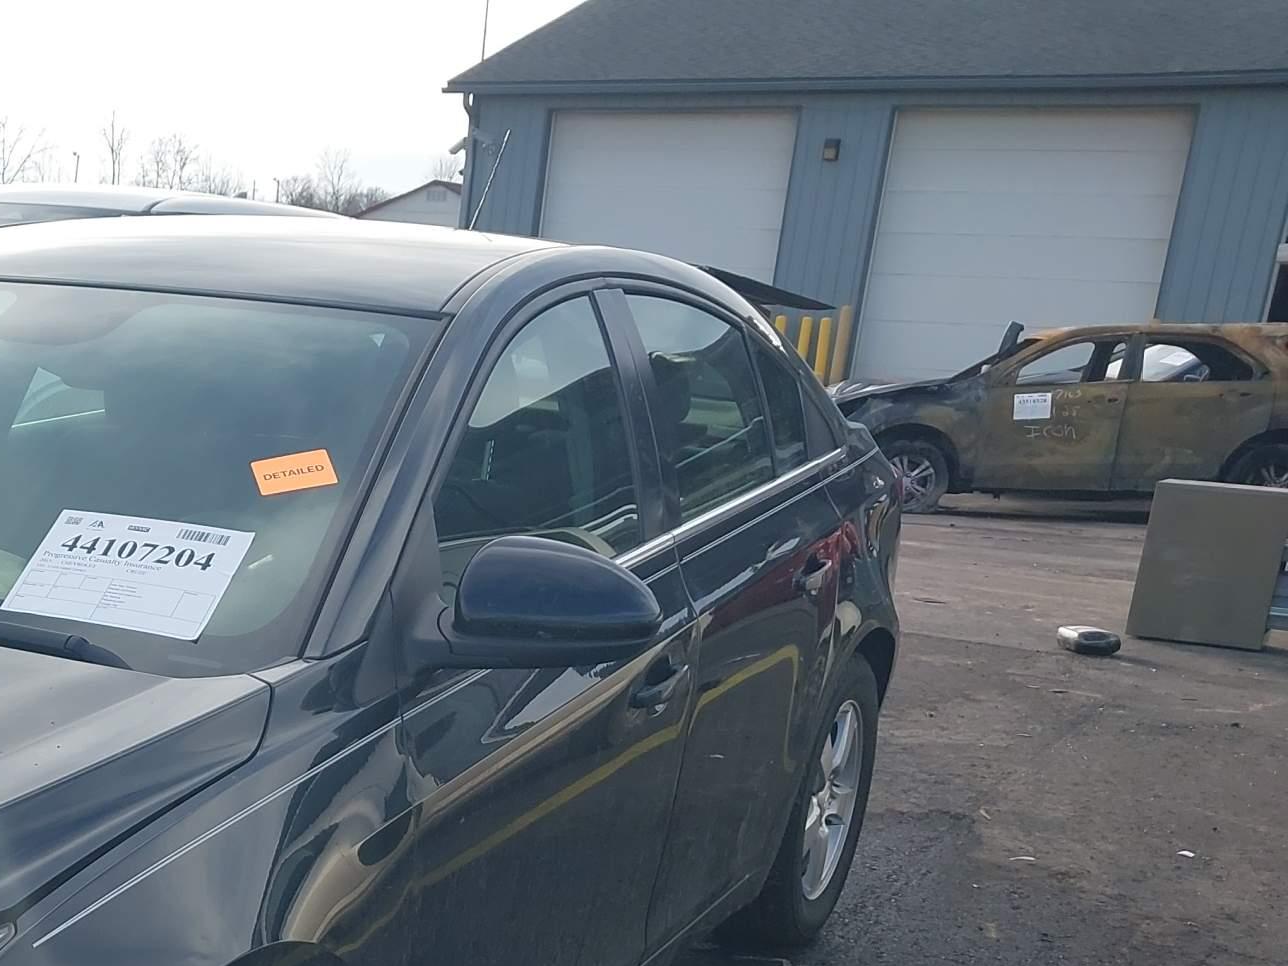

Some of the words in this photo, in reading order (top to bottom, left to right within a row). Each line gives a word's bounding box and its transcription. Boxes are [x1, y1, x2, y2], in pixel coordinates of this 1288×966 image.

[263, 464, 325, 481] DETAILED
[43, 550, 88, 562] Progressive
[88, 555, 120, 567] Casualty
[123, 560, 162, 571] Insurance
[61, 534, 216, 571] 44107204
